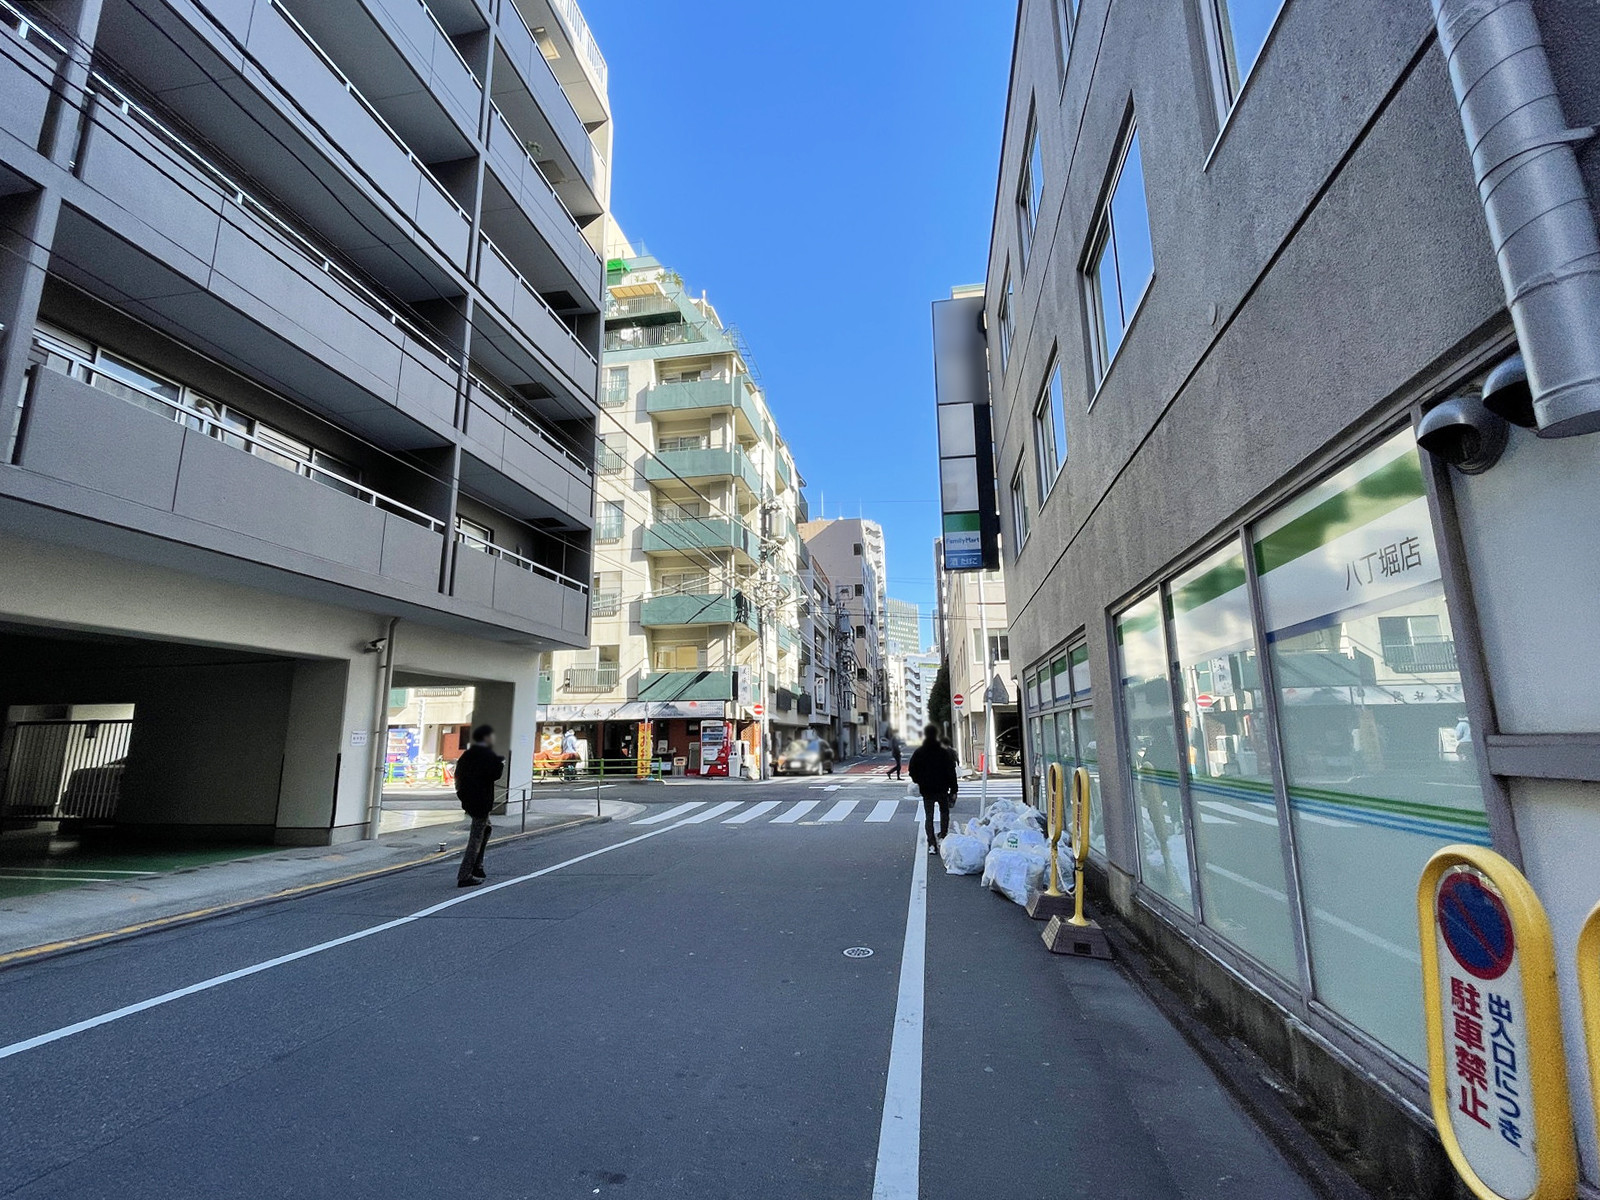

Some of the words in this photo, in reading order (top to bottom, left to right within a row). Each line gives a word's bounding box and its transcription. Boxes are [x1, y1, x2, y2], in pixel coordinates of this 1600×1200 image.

[947, 537, 980, 545] FamilyMart
[1346, 536, 1422, 591] 八丁堀店
[1450, 976, 1492, 1130] 駐車禁止
[1488, 992, 1523, 1149] 出入口につき
